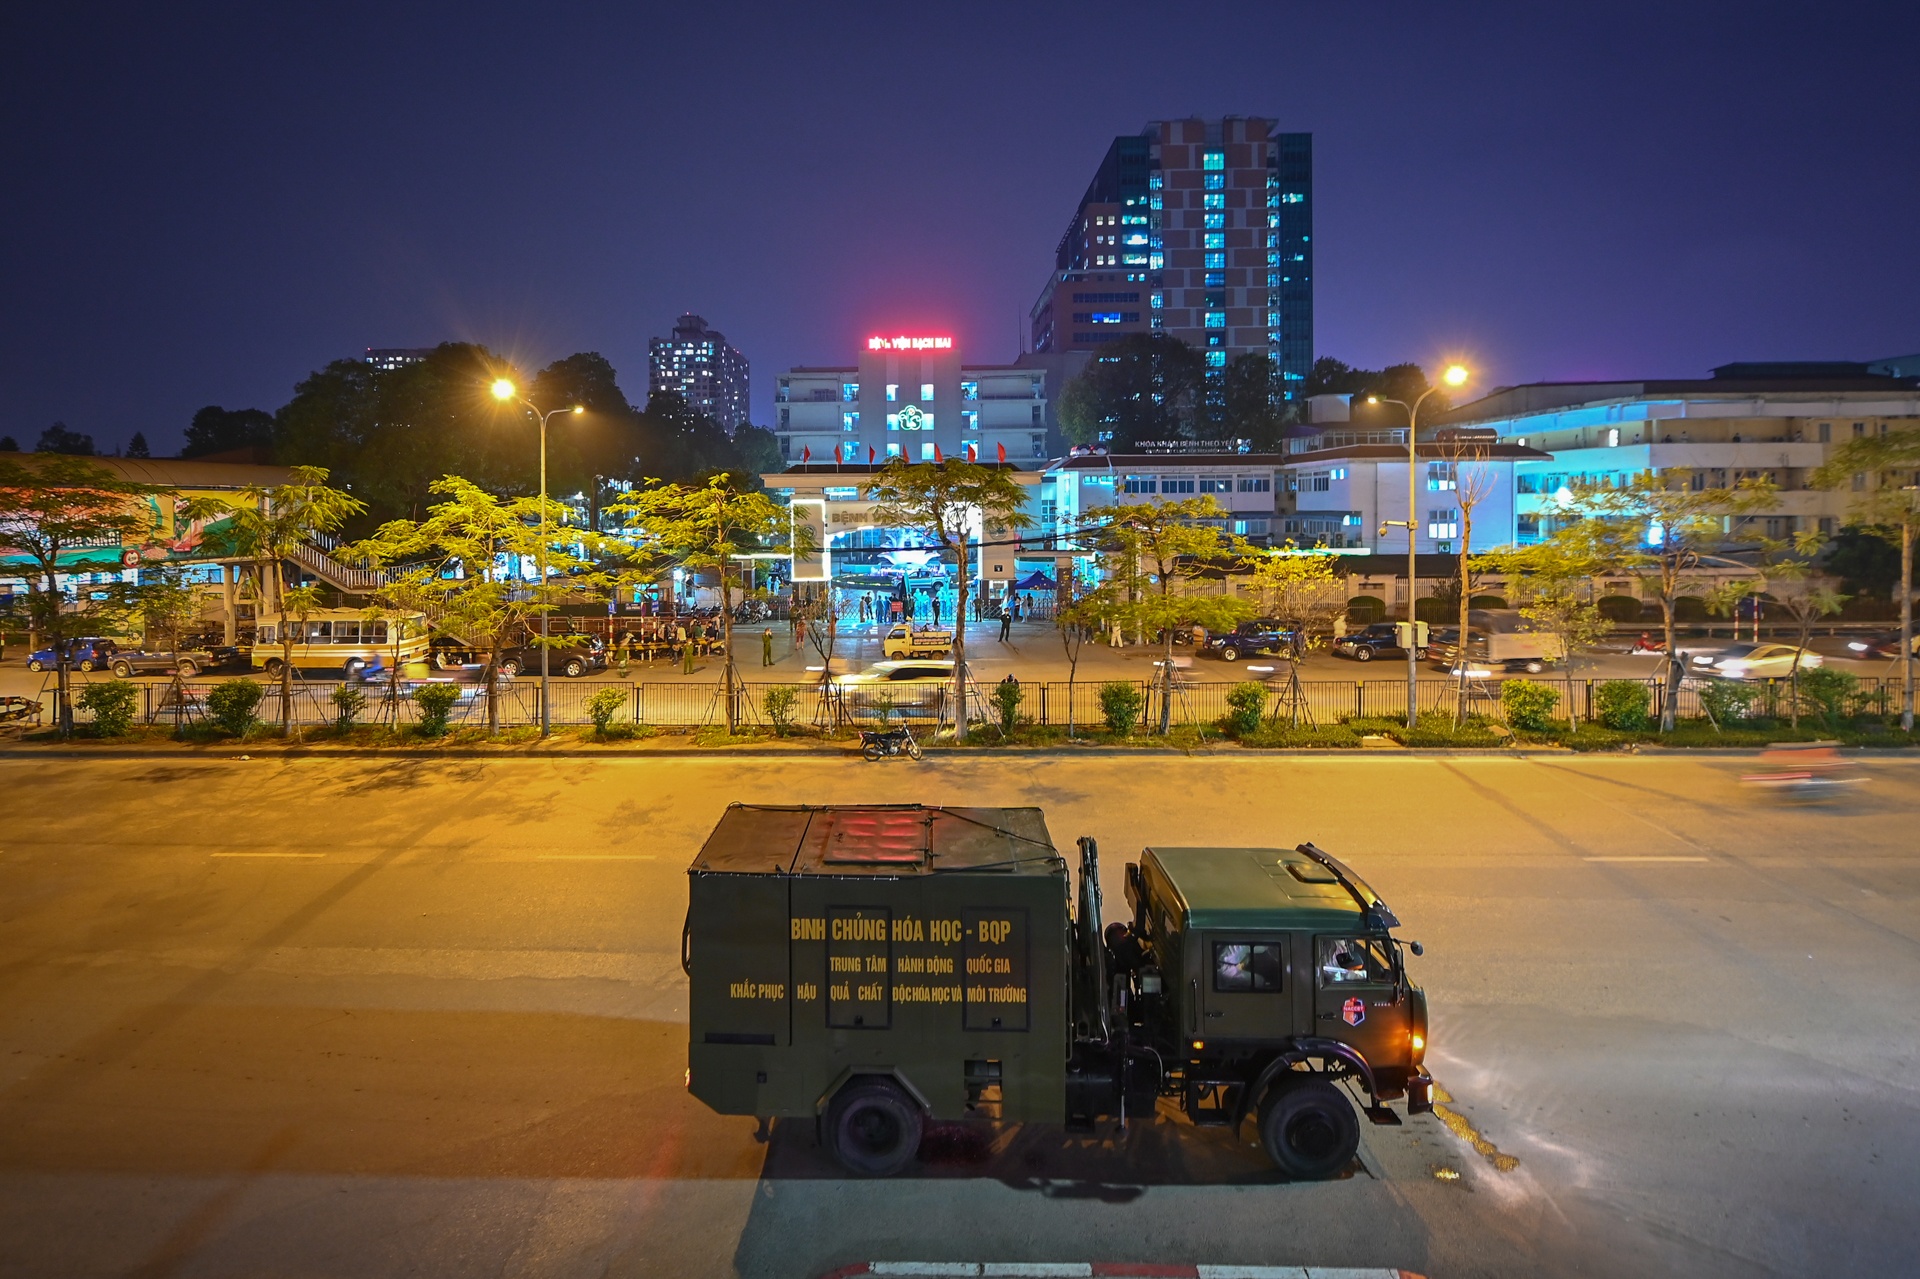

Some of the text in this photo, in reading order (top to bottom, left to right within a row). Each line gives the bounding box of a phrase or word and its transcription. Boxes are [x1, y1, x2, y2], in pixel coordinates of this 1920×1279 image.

[831, 510, 868, 526] BỆNH
[1438, 545, 1450, 553] K3
[791, 918, 826, 940] BINH
[831, 911, 886, 941] CHỦNG
[891, 914, 924, 941] HÓA
[930, 920, 962, 946] HỌC
[978, 920, 1011, 945] BQP
[829, 953, 1011, 976] TRUNG TÂM HÀNH ĐỘNG QUỐC GIA
[730, 978, 1027, 1004] KHẮC PHỤC HẬU QUẢ CHẤT ĐỘC HÓA HỌC VÀ MÔI TRƯỜNG
